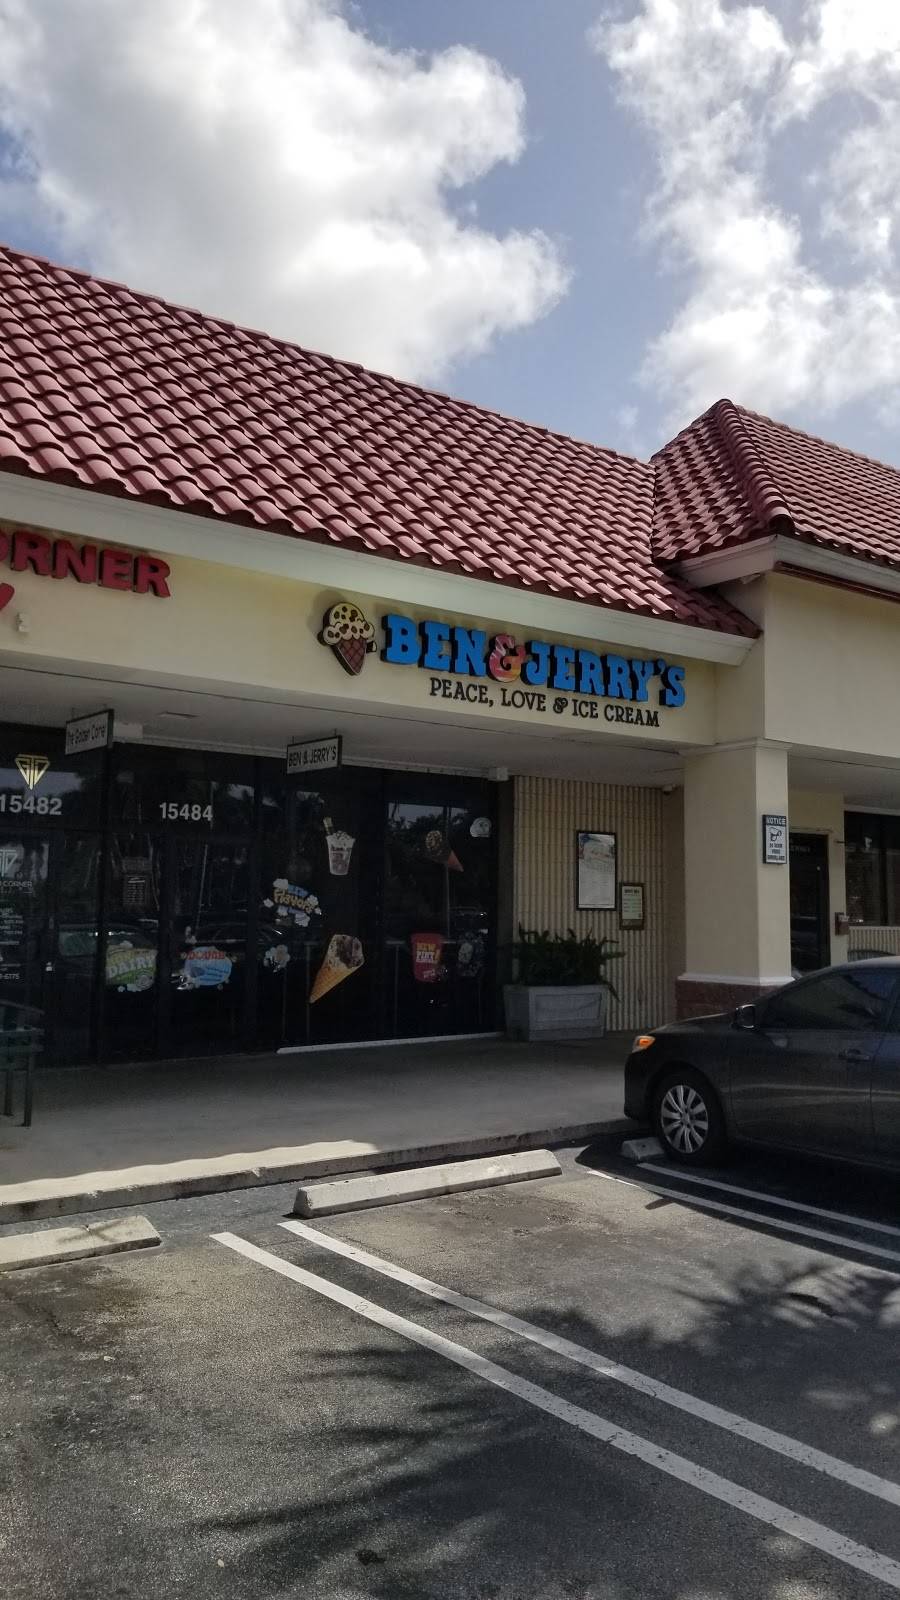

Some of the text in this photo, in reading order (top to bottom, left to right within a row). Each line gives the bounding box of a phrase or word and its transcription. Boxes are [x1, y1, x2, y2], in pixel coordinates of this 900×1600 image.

[381, 613, 686, 708] BEN & JERRY'S
[430, 677, 660, 727] PEACE, LOVE & ICE CREAM
[289, 751, 302, 767] BEN
[310, 746, 337, 764] JERRY'S
[0, 794, 62, 815] 15482
[160, 802, 213, 821] 15484
